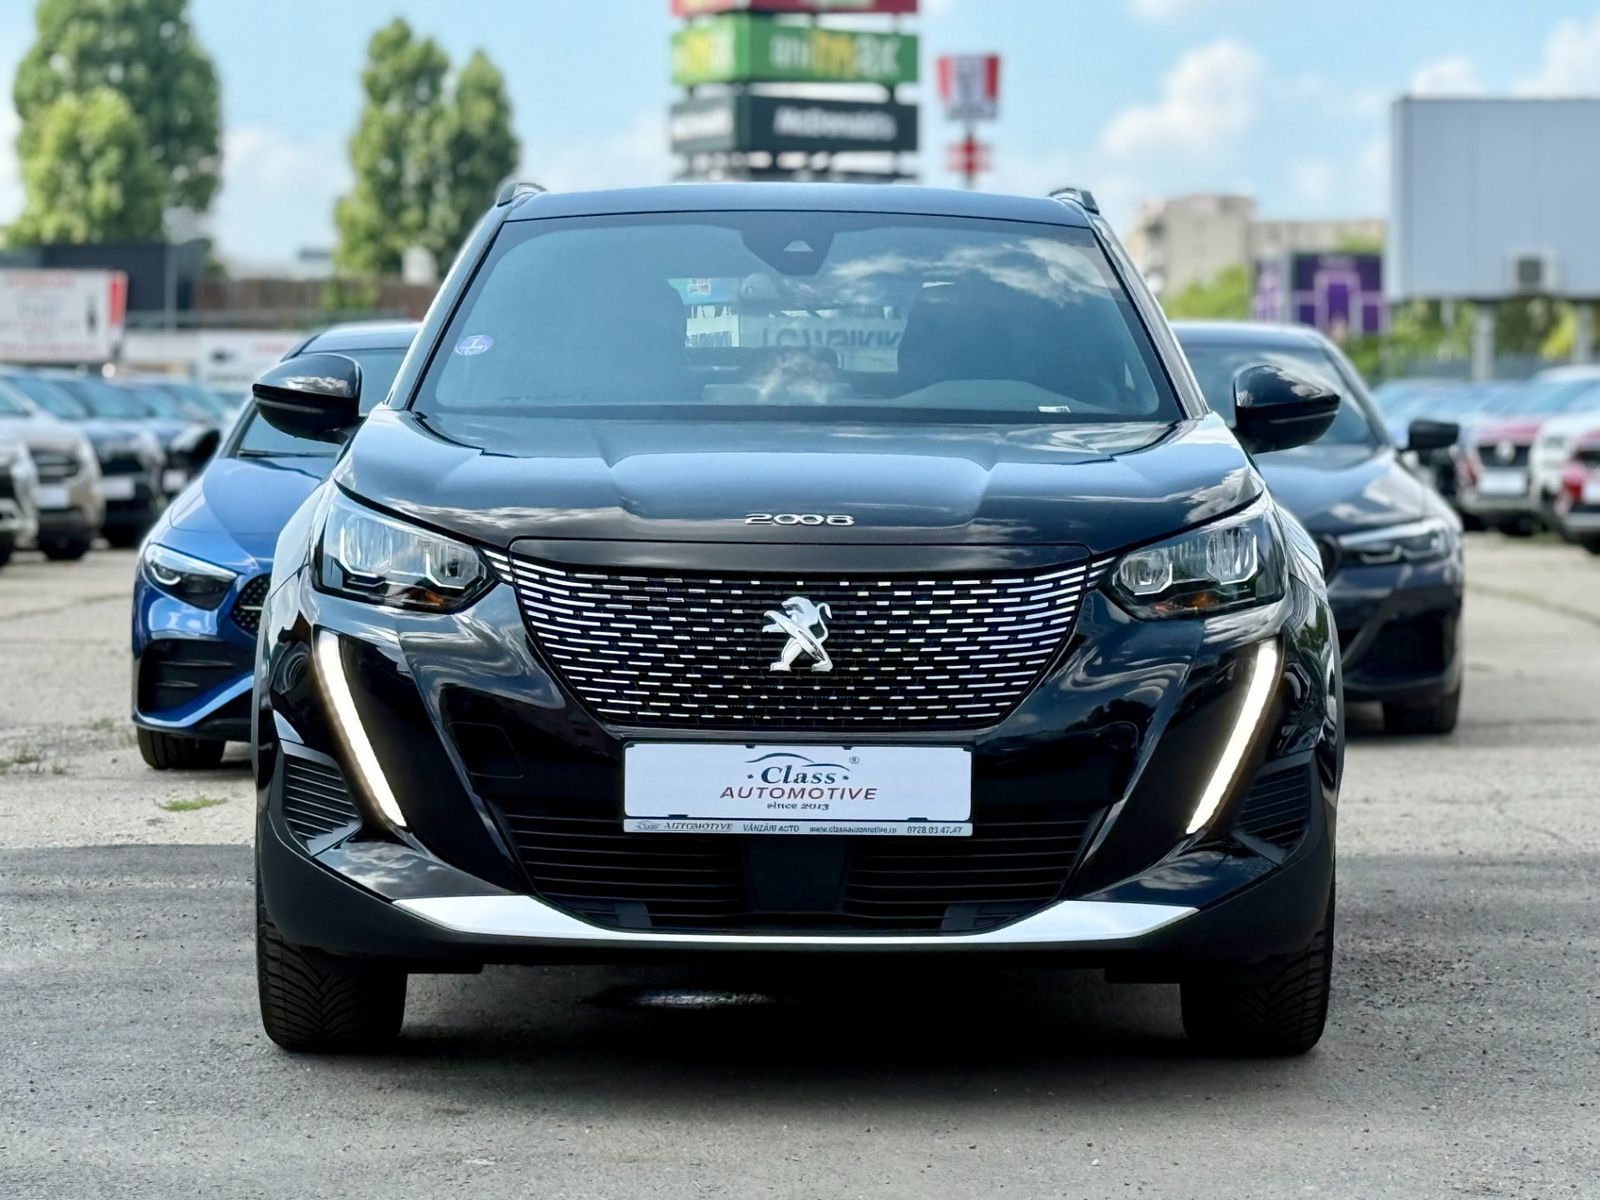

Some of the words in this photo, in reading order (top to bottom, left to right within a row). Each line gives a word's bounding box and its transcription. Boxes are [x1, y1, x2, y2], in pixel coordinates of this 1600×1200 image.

[745, 513, 855, 526] 2008
[761, 765, 837, 784] Class
[719, 786, 878, 800] AUTOMOTIVE
[767, 801, 798, 810] since
[800, 802, 830, 811] 2013
